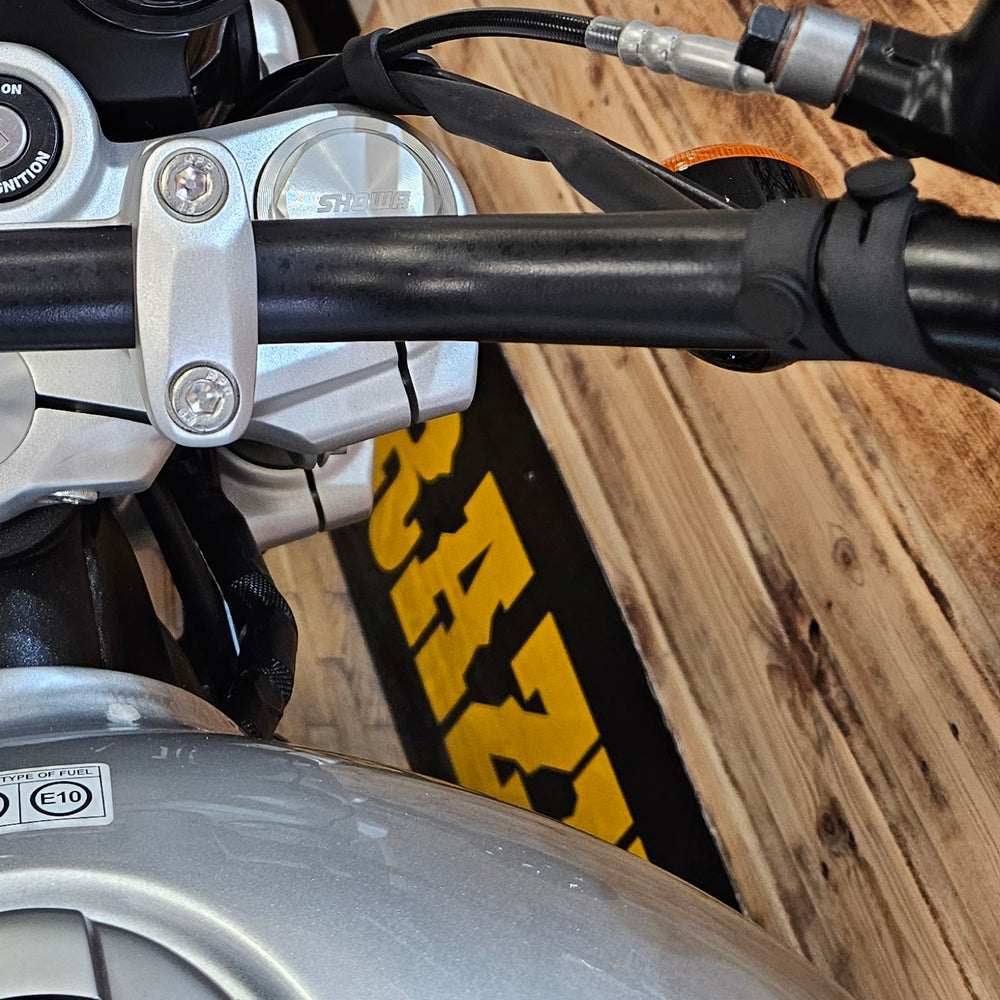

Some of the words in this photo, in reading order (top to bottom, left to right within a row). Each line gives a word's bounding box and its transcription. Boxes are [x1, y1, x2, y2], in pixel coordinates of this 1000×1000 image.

[1, 83, 22, 95] ON
[316, 190, 412, 213] SHOWA
[369, 412, 650, 862] RAZ
[0, 773, 34, 783] TYPE
[38, 770, 56, 778] OF
[59, 768, 94, 776] FUEL
[40, 790, 82, 805] E10
